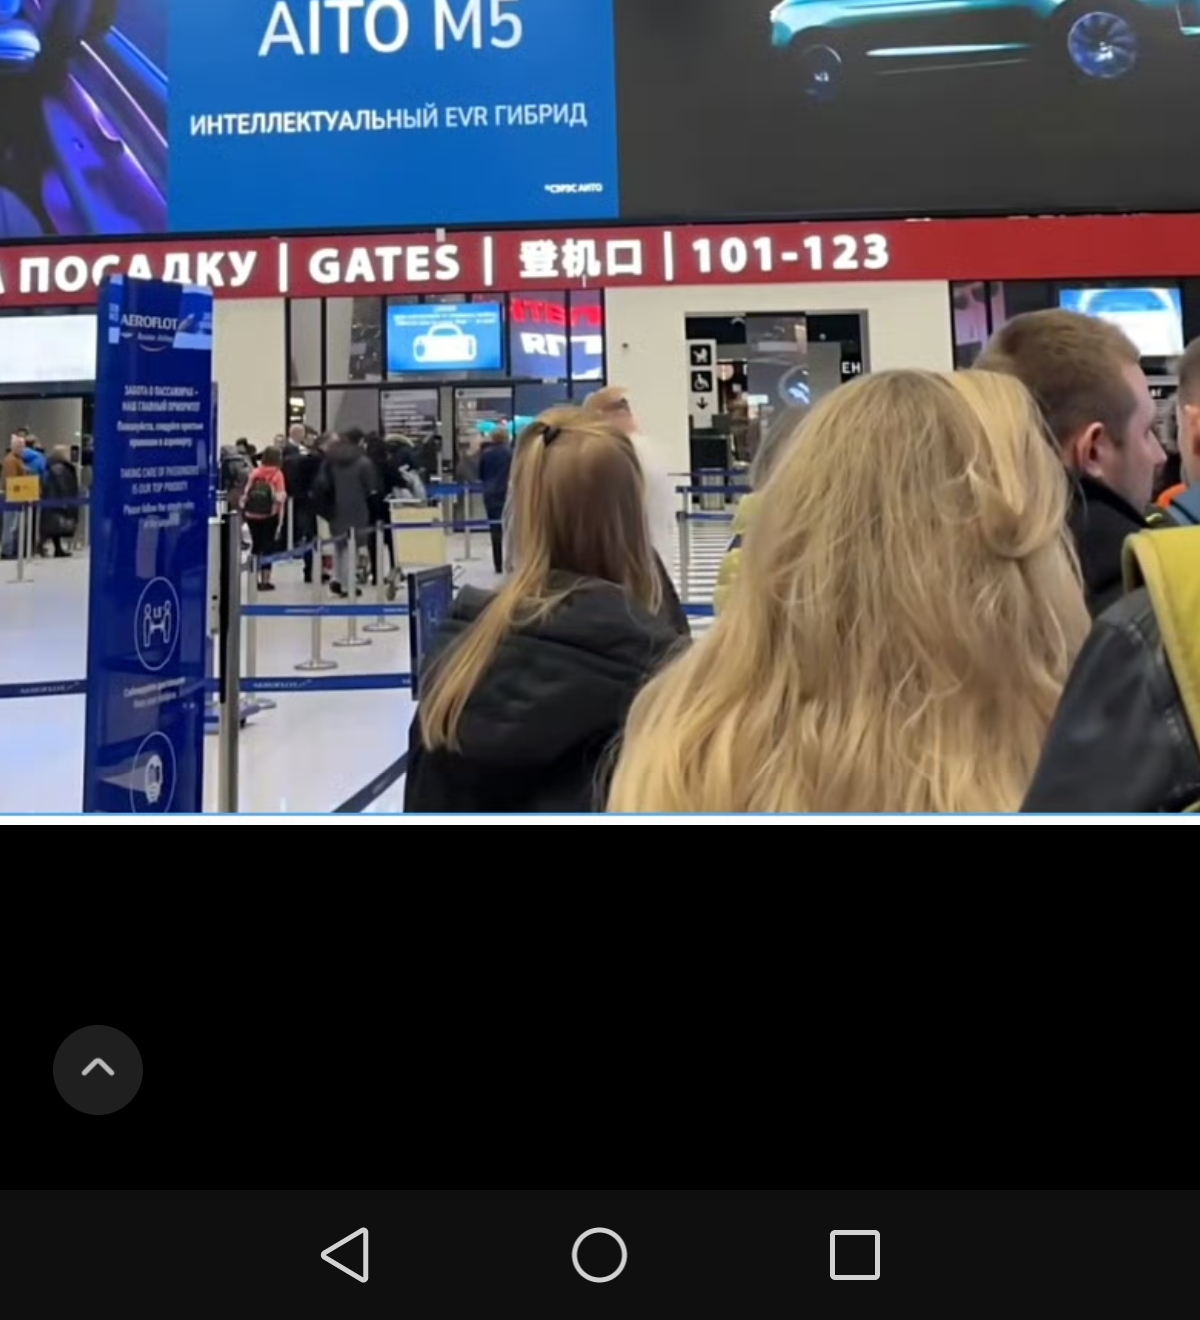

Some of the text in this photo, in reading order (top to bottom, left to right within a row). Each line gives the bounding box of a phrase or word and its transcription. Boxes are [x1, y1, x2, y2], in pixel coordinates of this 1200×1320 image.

[190, 102, 588, 136] ИНТЕЛЛЕКТУАЛЬНЫЙ EVR ГИБРИД
[20, 250, 257, 293] ПОСАДКУ
[308, 245, 460, 283] GATES
[519, 238, 643, 278] 登机口
[692, 233, 889, 273] 101-123
[121, 314, 178, 330] AEROFLOT
